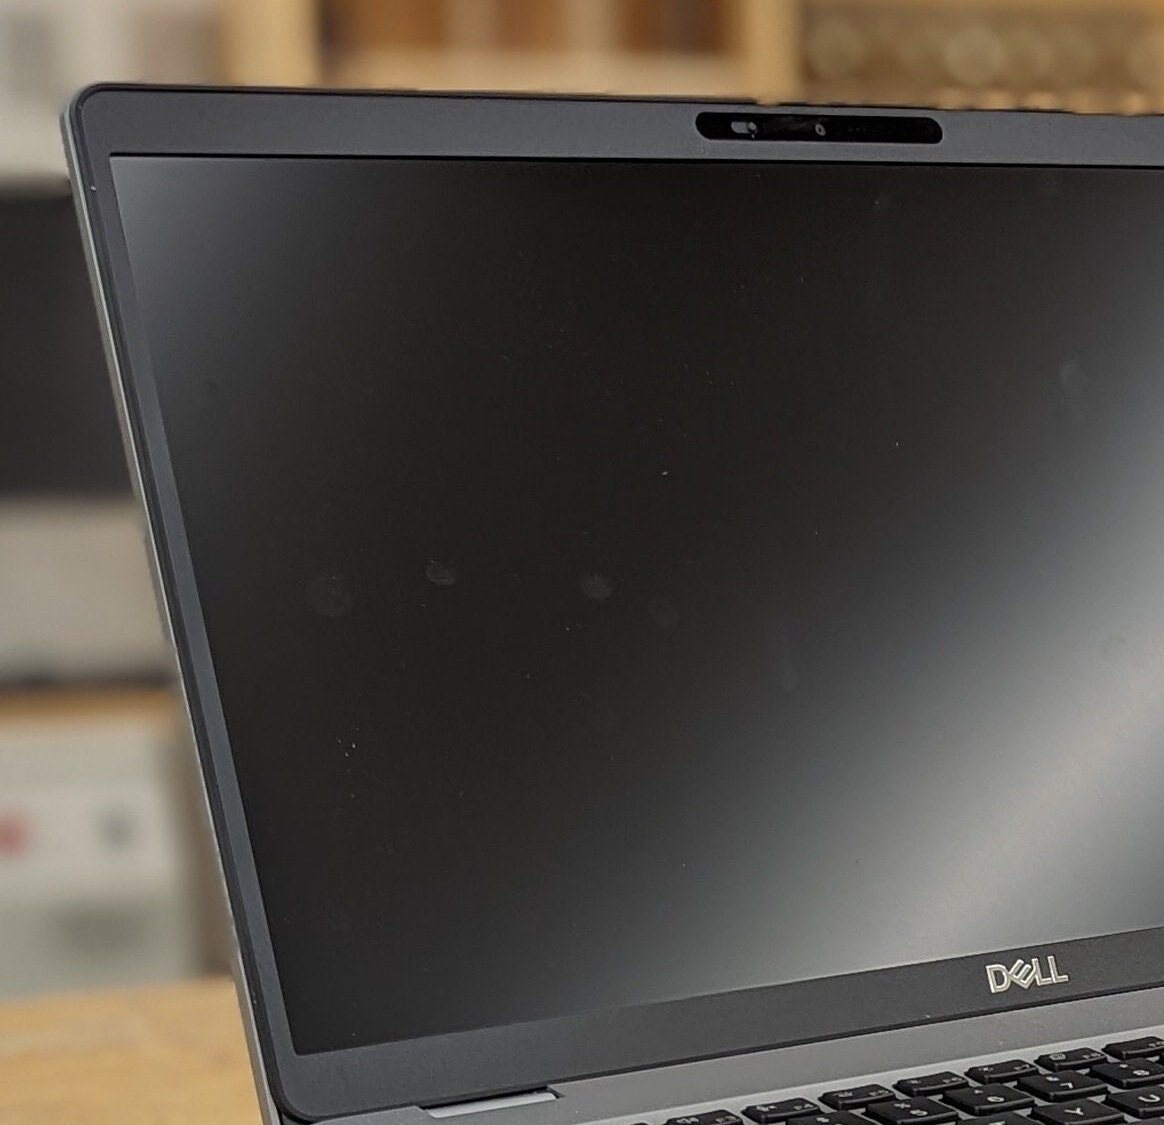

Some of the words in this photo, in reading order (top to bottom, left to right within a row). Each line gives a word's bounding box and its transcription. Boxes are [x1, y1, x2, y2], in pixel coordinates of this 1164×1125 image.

[986, 955, 1069, 994] DELL
[1138, 1093, 1161, 1103] U
[1063, 1107, 1085, 1117] Y
